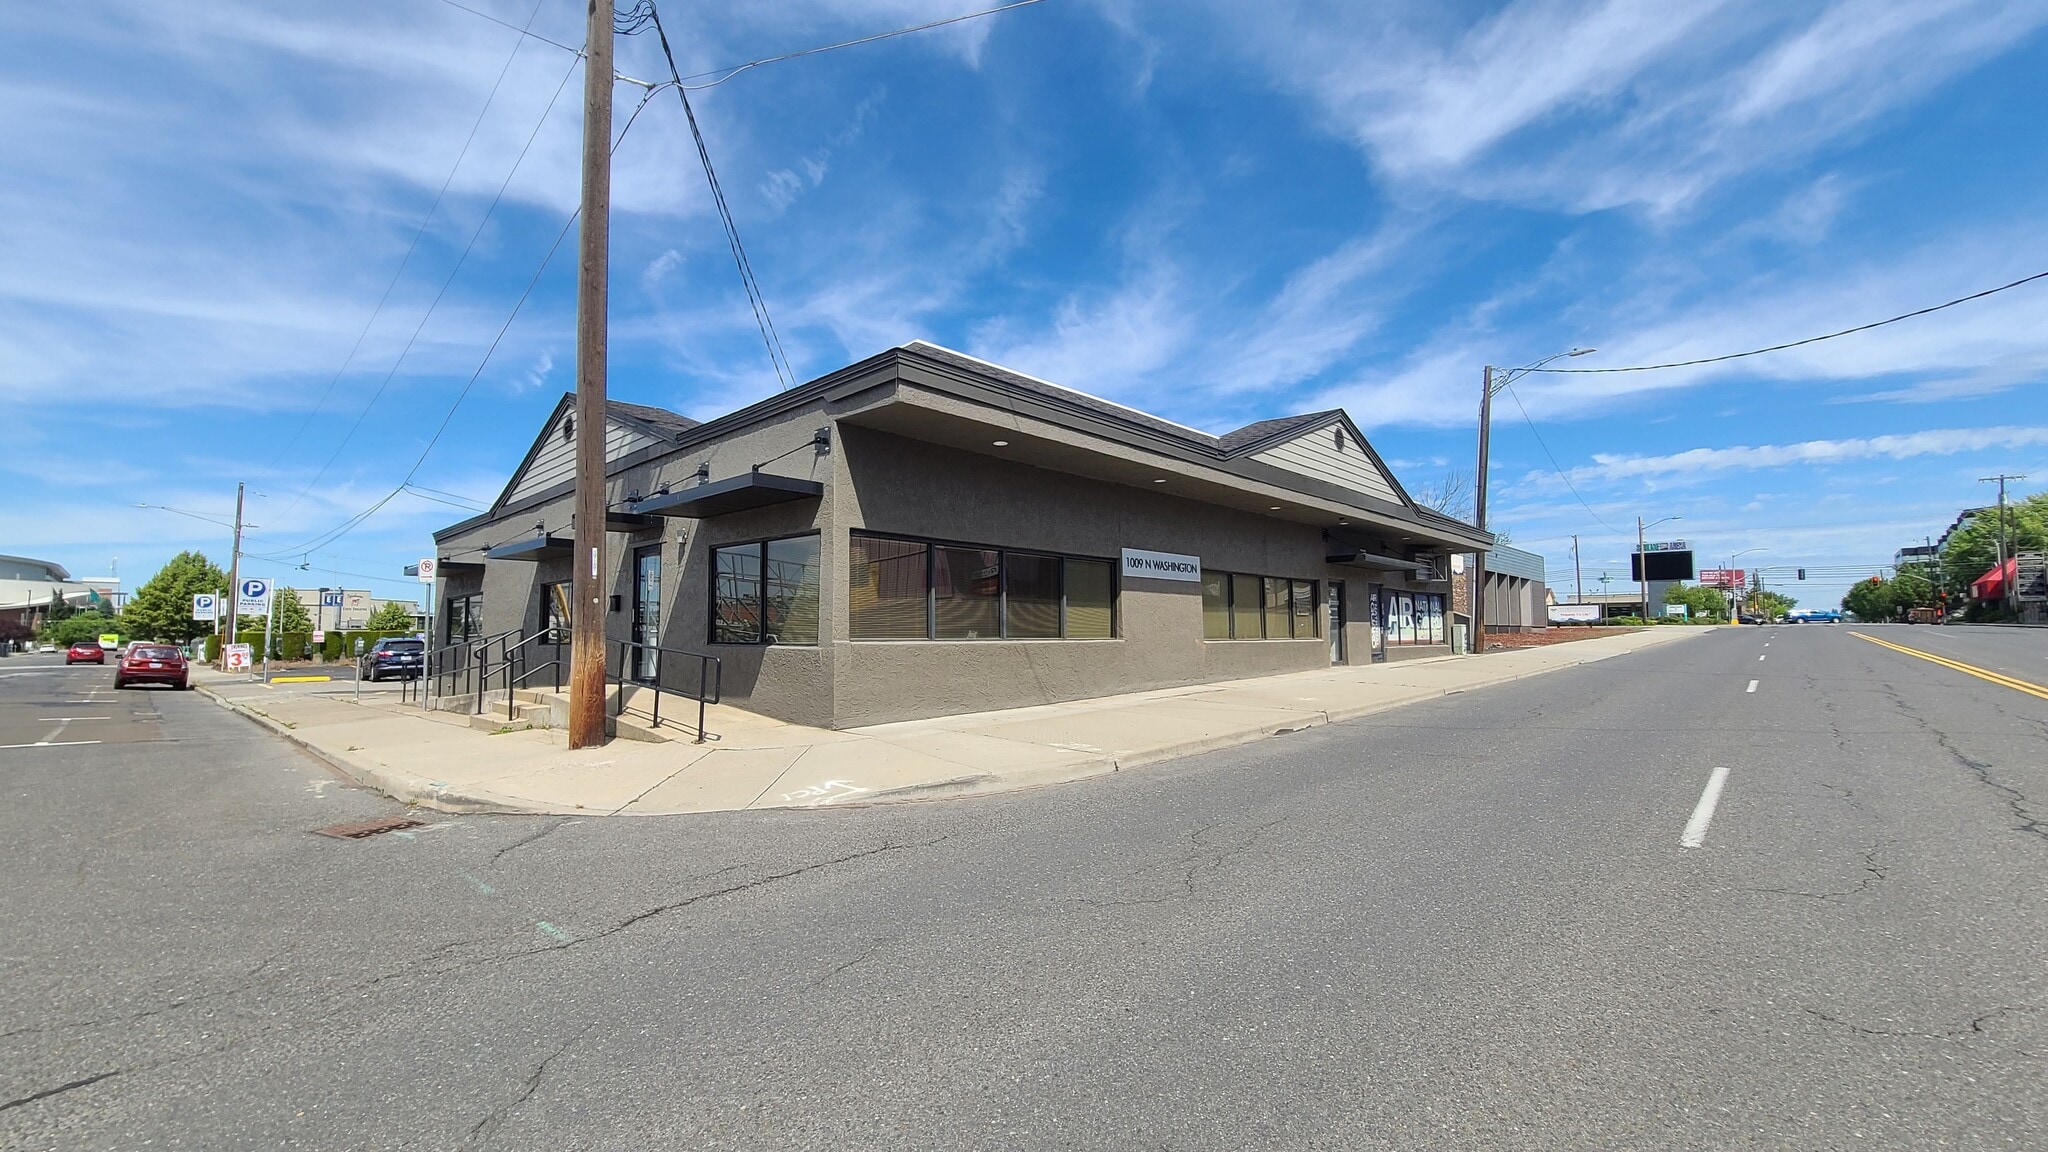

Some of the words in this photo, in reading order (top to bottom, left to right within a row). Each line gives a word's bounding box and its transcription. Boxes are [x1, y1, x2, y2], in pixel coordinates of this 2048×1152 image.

[1126, 557, 1143, 568] 1009
[1145, 560, 1151, 570] N
[1152, 560, 1198, 574] WASHINGTON
[1388, 596, 1414, 628] AIR
[1415, 600, 1441, 612] NATINAL
